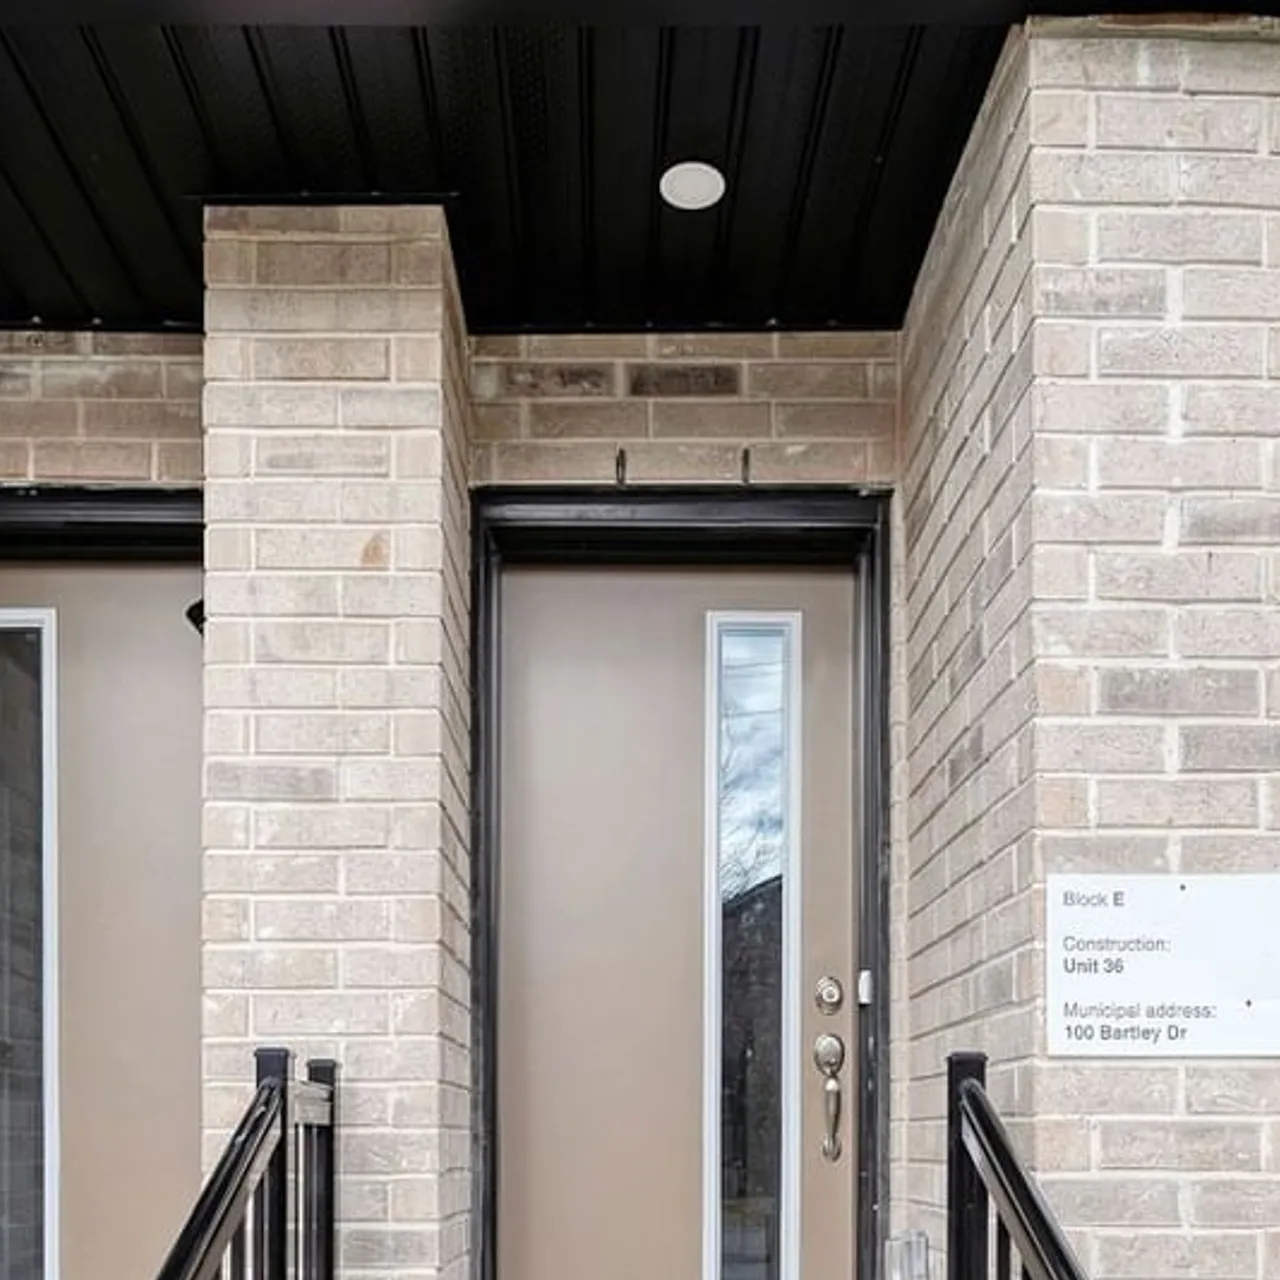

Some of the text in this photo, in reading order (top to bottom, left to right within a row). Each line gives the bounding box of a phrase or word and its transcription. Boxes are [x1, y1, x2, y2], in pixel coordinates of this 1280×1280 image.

[1063, 891, 1125, 907] Block E
[1063, 936, 1171, 952] Construction:
[1063, 957, 1124, 974] Unit 36
[1064, 1001, 1218, 1020] Municipal address:
[1065, 1024, 1188, 1044] 100 Bartley Dr
